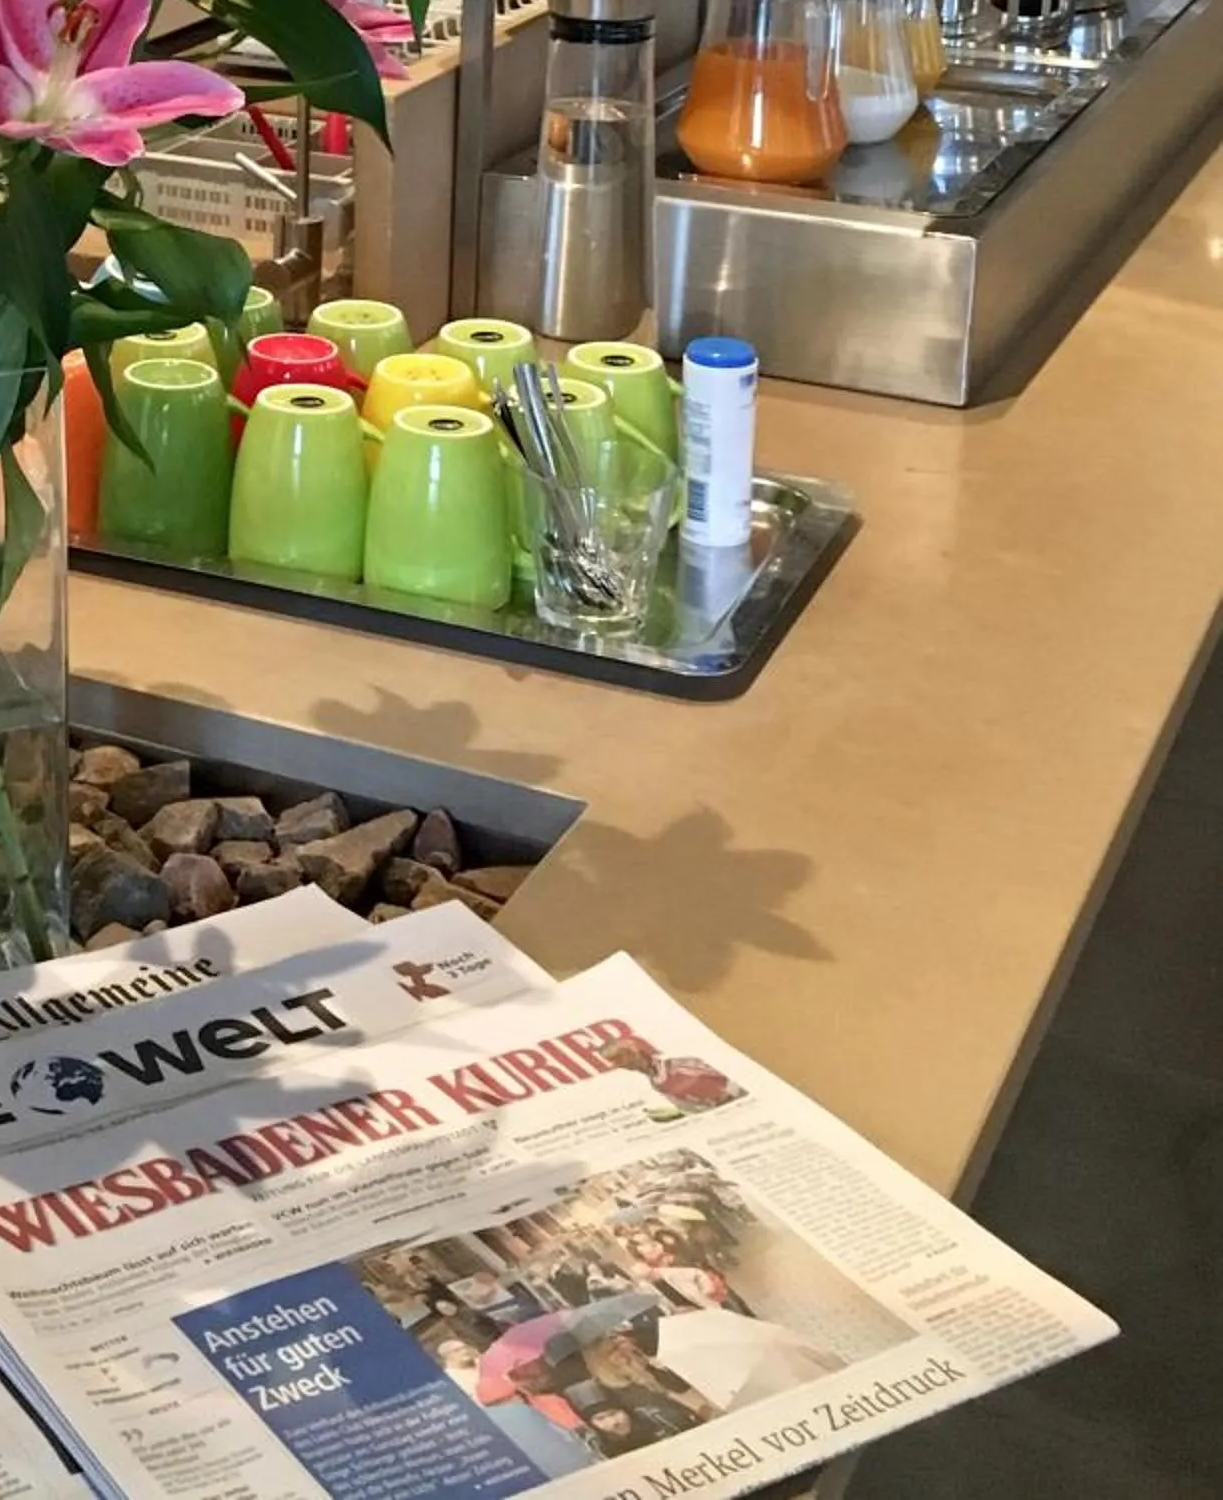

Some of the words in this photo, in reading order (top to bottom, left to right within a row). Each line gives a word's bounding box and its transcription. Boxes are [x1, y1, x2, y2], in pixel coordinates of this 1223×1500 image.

[426, 1018, 664, 1116] KURIER
[203, 1294, 339, 1355] Anstehen
[224, 1347, 274, 1382] für
[278, 1322, 364, 1373] guten
[248, 1362, 353, 1413] Zweck
[641, 1436, 764, 1499] Merkel
[761, 1417, 817, 1456] vor
[812, 1355, 967, 1434] Zeitdruck
